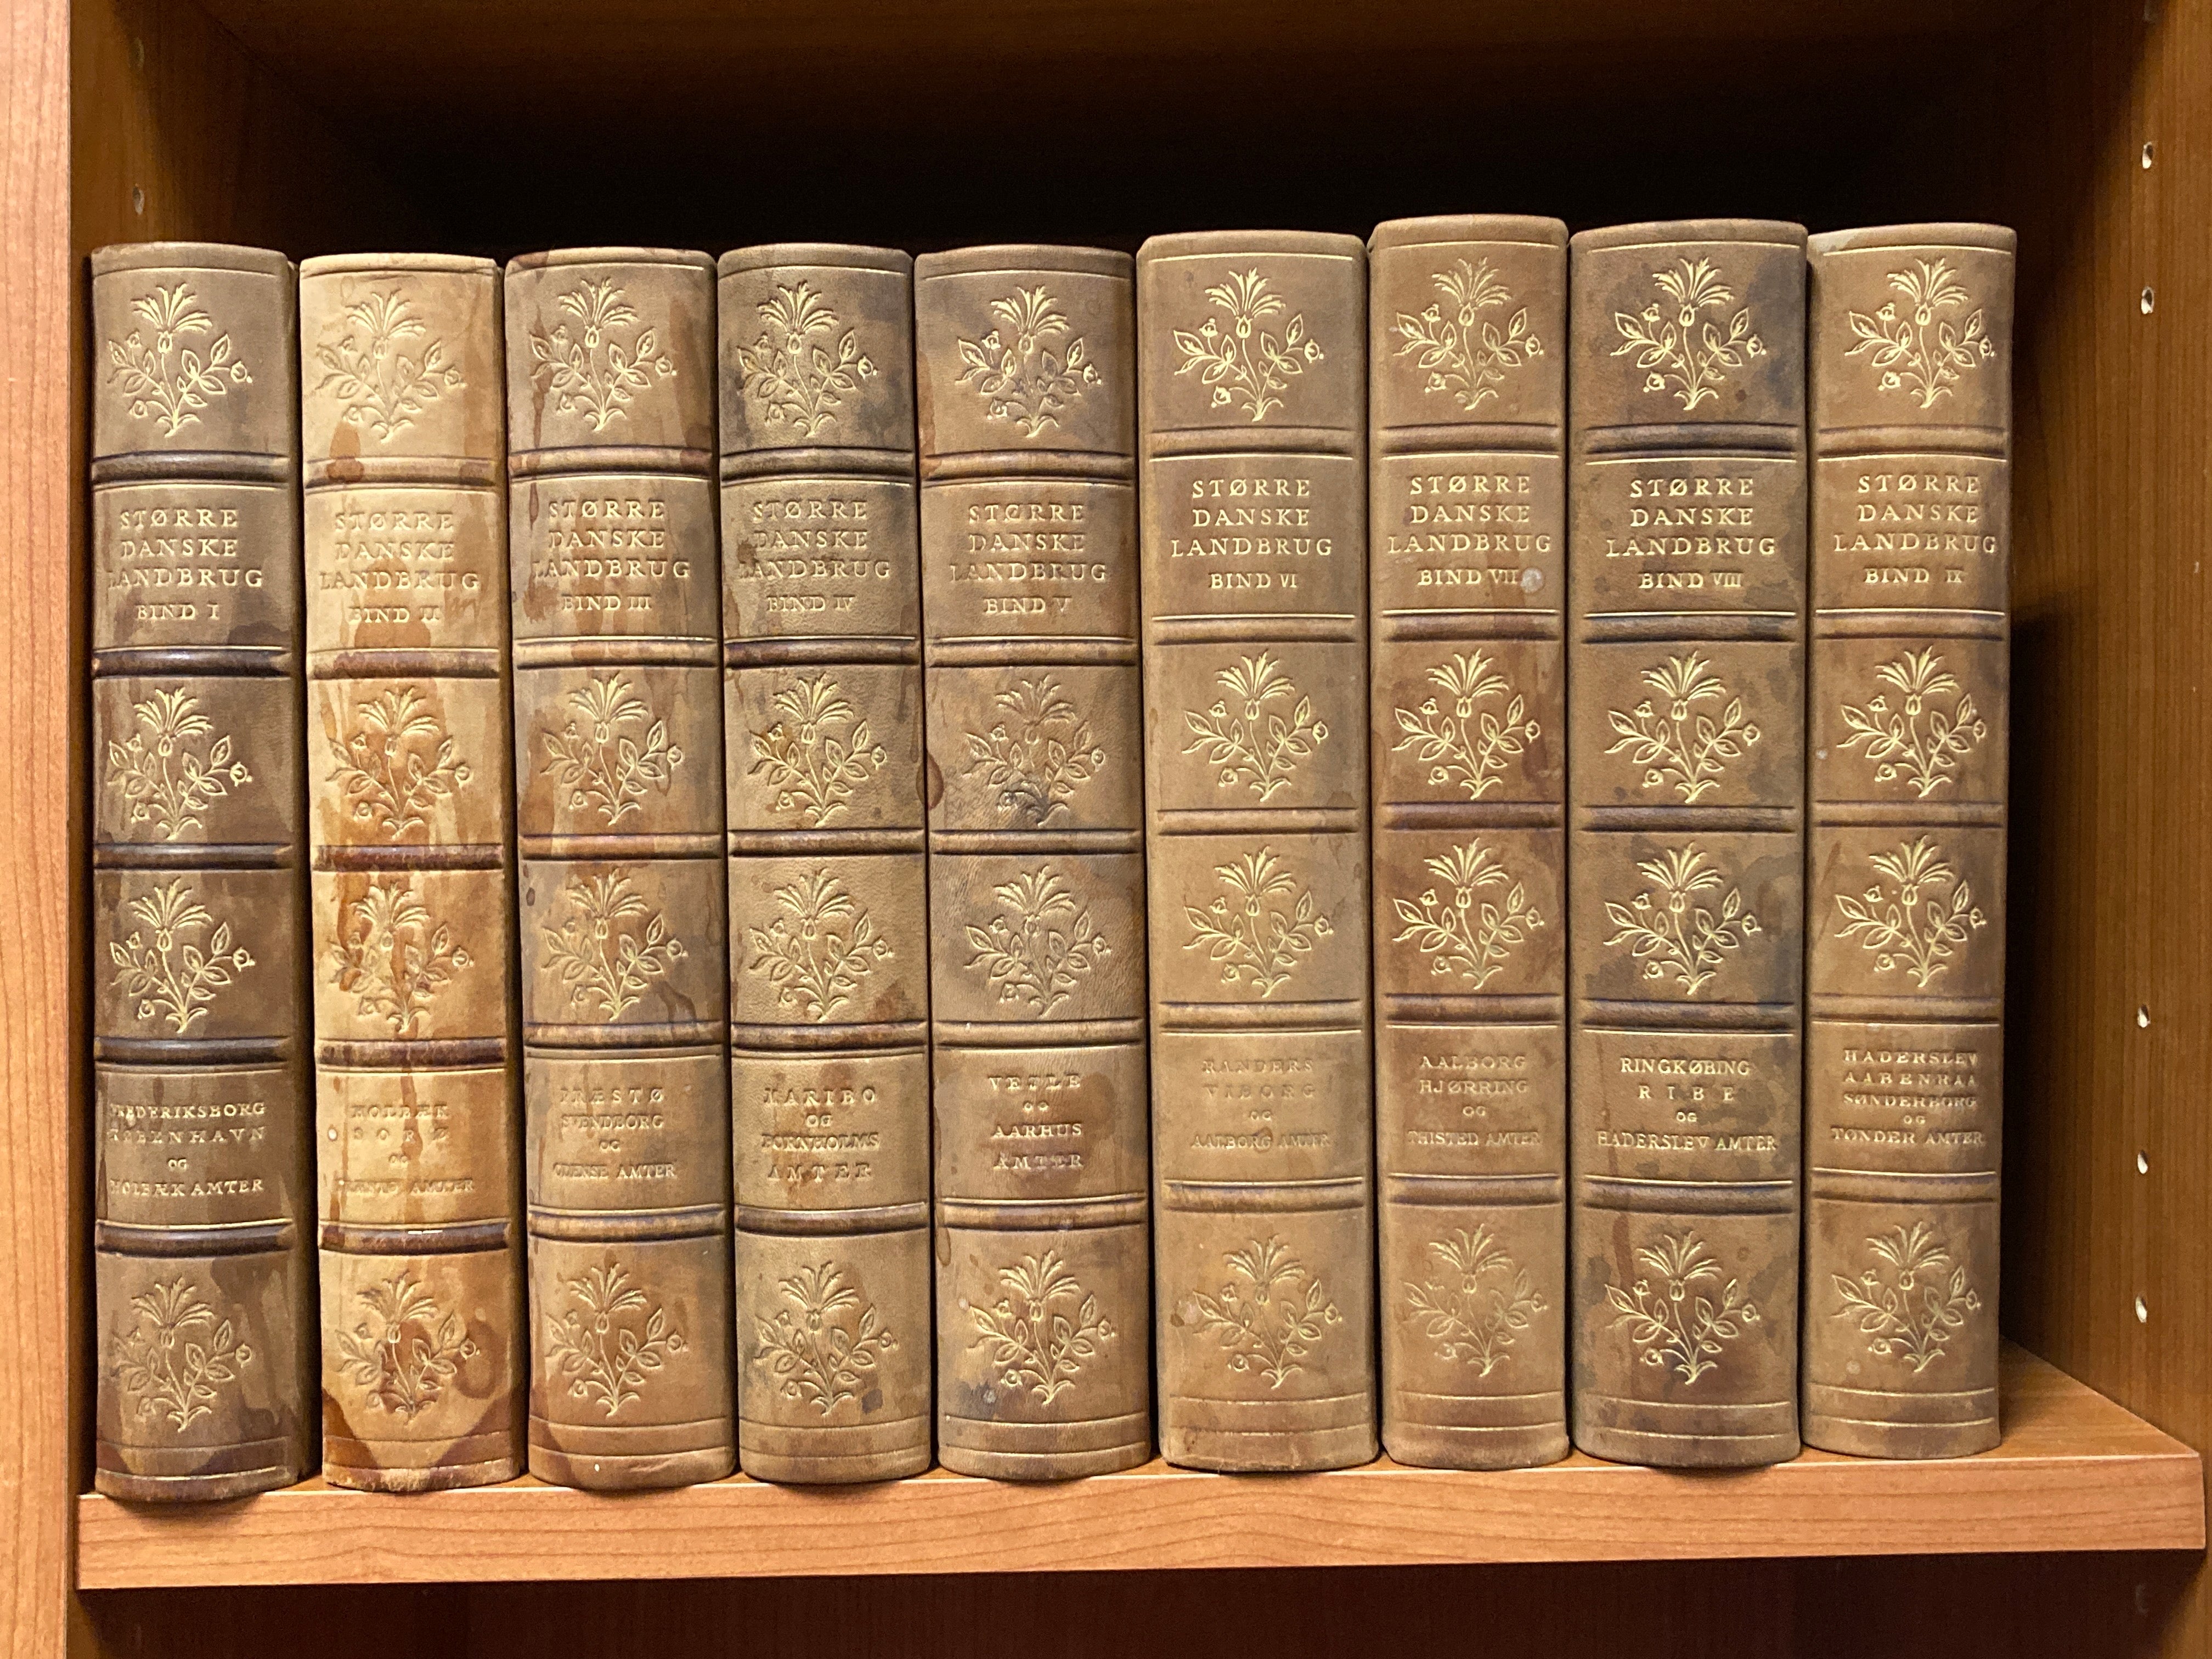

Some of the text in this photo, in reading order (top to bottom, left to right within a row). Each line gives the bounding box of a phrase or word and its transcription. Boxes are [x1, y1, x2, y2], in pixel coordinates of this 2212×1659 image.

[1192, 478, 1310, 498] STØRRE
[1410, 475, 1530, 495] STØRRE
[1630, 478, 1753, 498] STØRRE
[1857, 473, 1980, 493] STØRRE
[120, 508, 239, 529] STØRRE
[549, 500, 666, 520] STØRRE
[753, 500, 867, 523] STØRRE
[969, 504, 1085, 523] STØRRE
[1193, 509, 1310, 527] DANSKE
[1410, 505, 1530, 523] DANSKE
[1630, 507, 1753, 527] DANSKE
[1858, 504, 1979, 522] DANSKE
[335, 512, 454, 532] STØRRE
[549, 529, 665, 549] DANSKE
[754, 530, 868, 550] DANSKE
[969, 533, 1085, 552] DANSKE
[1171, 538, 1331, 557] LANDBRUG
[1388, 534, 1551, 554] LANDBRUG
[1606, 537, 1775, 557] LANDBRUG
[1834, 533, 1996, 554] LANDBRUG
[120, 538, 238, 560] DANSKE
[335, 543, 454, 561] DANSKE
[533, 560, 691, 579] LANDBRUG
[950, 562, 1107, 582] LANDBRUG
[1418, 568, 1519, 585] BIND VII
[1865, 568, 1965, 584] BIND IX
[320, 571, 481, 590] LANDBRUG
[1209, 573, 1298, 589] BIND VI
[1638, 572, 1743, 589] BIND VIII
[137, 603, 220, 620] BIND I
[562, 595, 652, 611] BIND III
[766, 595, 855, 612] BIND IV
[984, 597, 1071, 614] BIND V
[348, 606, 440, 624] BIND II
[1420, 1056, 1526, 1070] AALBORG
[1843, 1049, 1978, 1065] HADERSLEV
[1620, 1058, 1751, 1076] RINGKØBING
[1419, 1079, 1528, 1094] HJØRRING
[1843, 1072, 1976, 1086] AABENRAA
[1638, 1085, 1734, 1101] RIBE
[1843, 1093, 1976, 1108] SØNDERBORG
[1463, 1105, 1486, 1117] OG
[1677, 1111, 1697, 1122] OG
[1904, 1115, 1926, 1124] OG
[805, 1114, 833, 1127] OG
[990, 1123, 1082, 1139] AARHUS
[1408, 1130, 1542, 1147] THISTED AMTER
[1831, 1127, 1984, 1144] TØNDER AMTER
[599, 1139, 621, 1153] OG
[1191, 1133, 1272, 1149] AALBORG
[1597, 1130, 1777, 1151] HADERSLEV AMTER
[168, 1159, 187, 1171] OG
[617, 1163, 678, 1179] AMTER
[191, 1178, 263, 1196] AMTER
